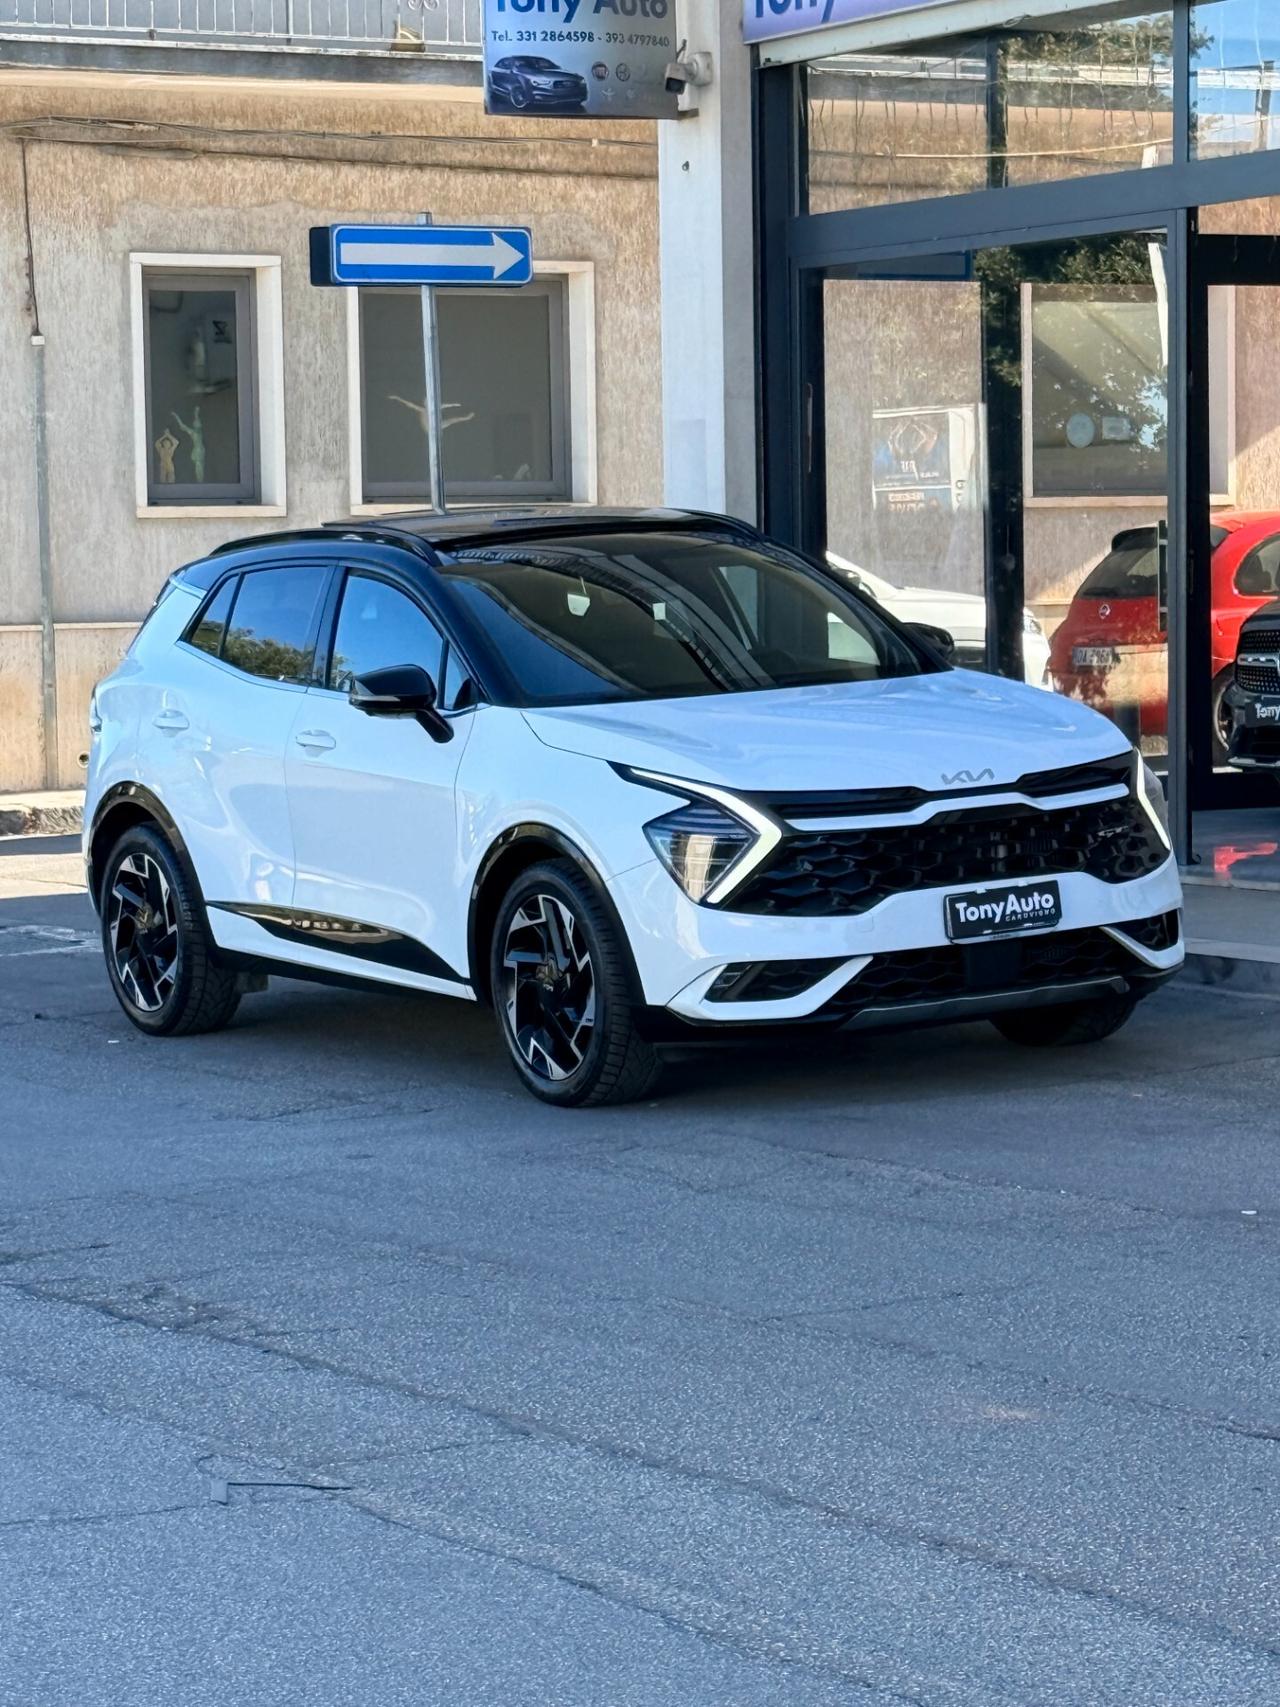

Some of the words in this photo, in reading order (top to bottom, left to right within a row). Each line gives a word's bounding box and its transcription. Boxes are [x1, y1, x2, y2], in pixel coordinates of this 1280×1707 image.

[491, 29, 513, 42] Tel.
[516, 30, 537, 42] 331
[540, 30, 595, 43] 2864598
[605, 32, 625, 45] 393
[627, 33, 670, 48] 4797840
